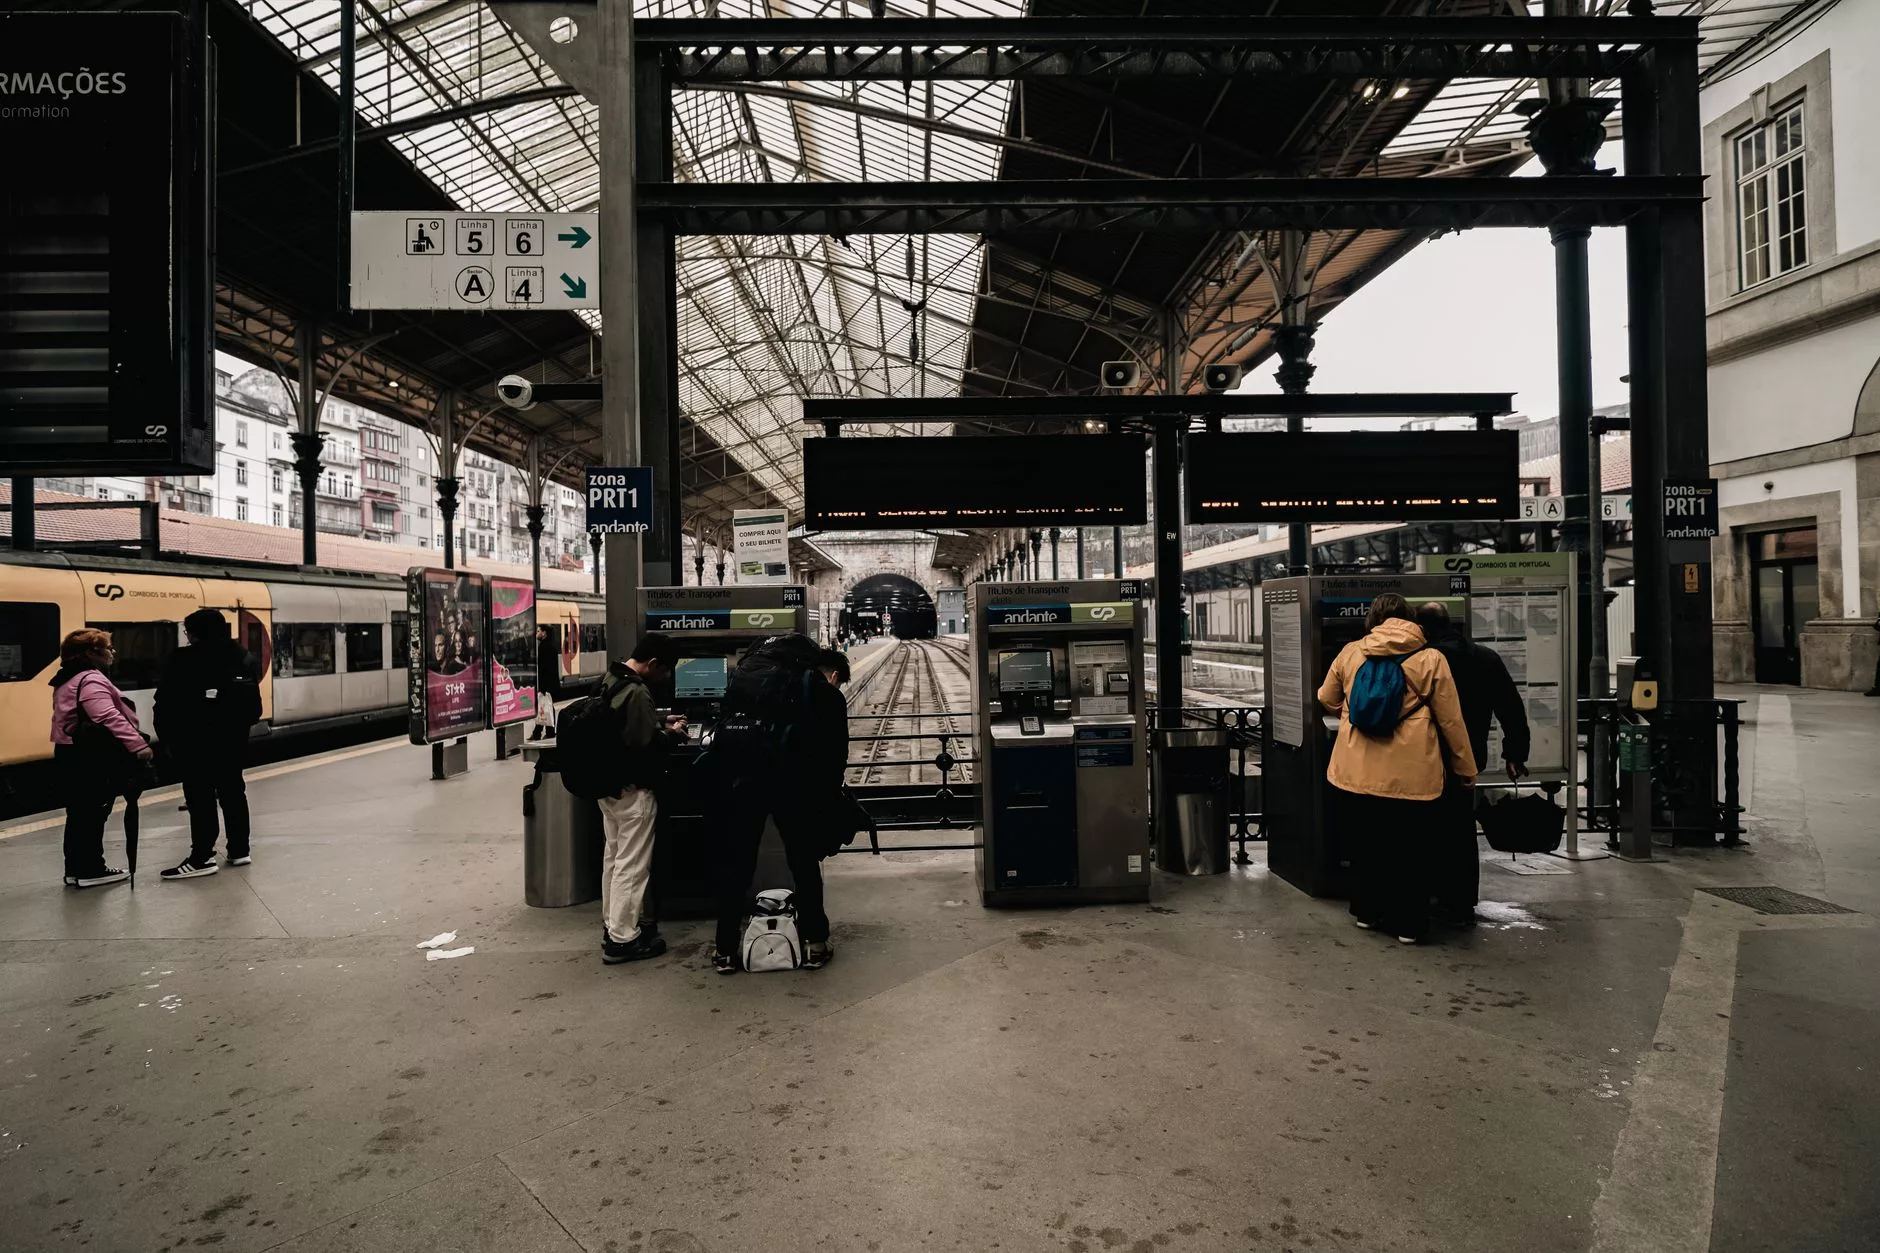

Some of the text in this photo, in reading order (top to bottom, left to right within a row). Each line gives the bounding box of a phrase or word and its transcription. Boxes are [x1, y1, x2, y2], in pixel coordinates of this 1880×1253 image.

[461, 221, 488, 229] Linha
[467, 231, 483, 253] 5
[516, 232, 532, 254] 6
[463, 274, 486, 296] A
[515, 278, 532, 302] 4
[589, 475, 626, 486] zona
[1665, 485, 1695, 496] zona
[589, 488, 637, 508] PRT1
[1525, 505, 1534, 517] 5
[1547, 503, 1558, 515] A
[1604, 504, 1612, 516] 6
[1665, 497, 1705, 516] PRT1
[590, 519, 649, 533] andante
[1666, 525, 1716, 538] andante
[739, 530, 765, 538] COMPRE
[758, 538, 781, 546] BILHETE
[1476, 561, 1507, 569] COMBOIOS
[1509, 561, 1517, 569] DE
[1519, 560, 1551, 569] PORTUGAL
[129, 590, 159, 598] COMBOIOS
[675, 589, 686, 599] de
[688, 590, 732, 600] Transporte
[784, 593, 800, 601] PRT1
[1015, 586, 1025, 595] de
[1028, 586, 1070, 596] Transporte
[1339, 602, 1371, 616] anda
[660, 615, 714, 629] andante
[1004, 609, 1057, 624] andante
